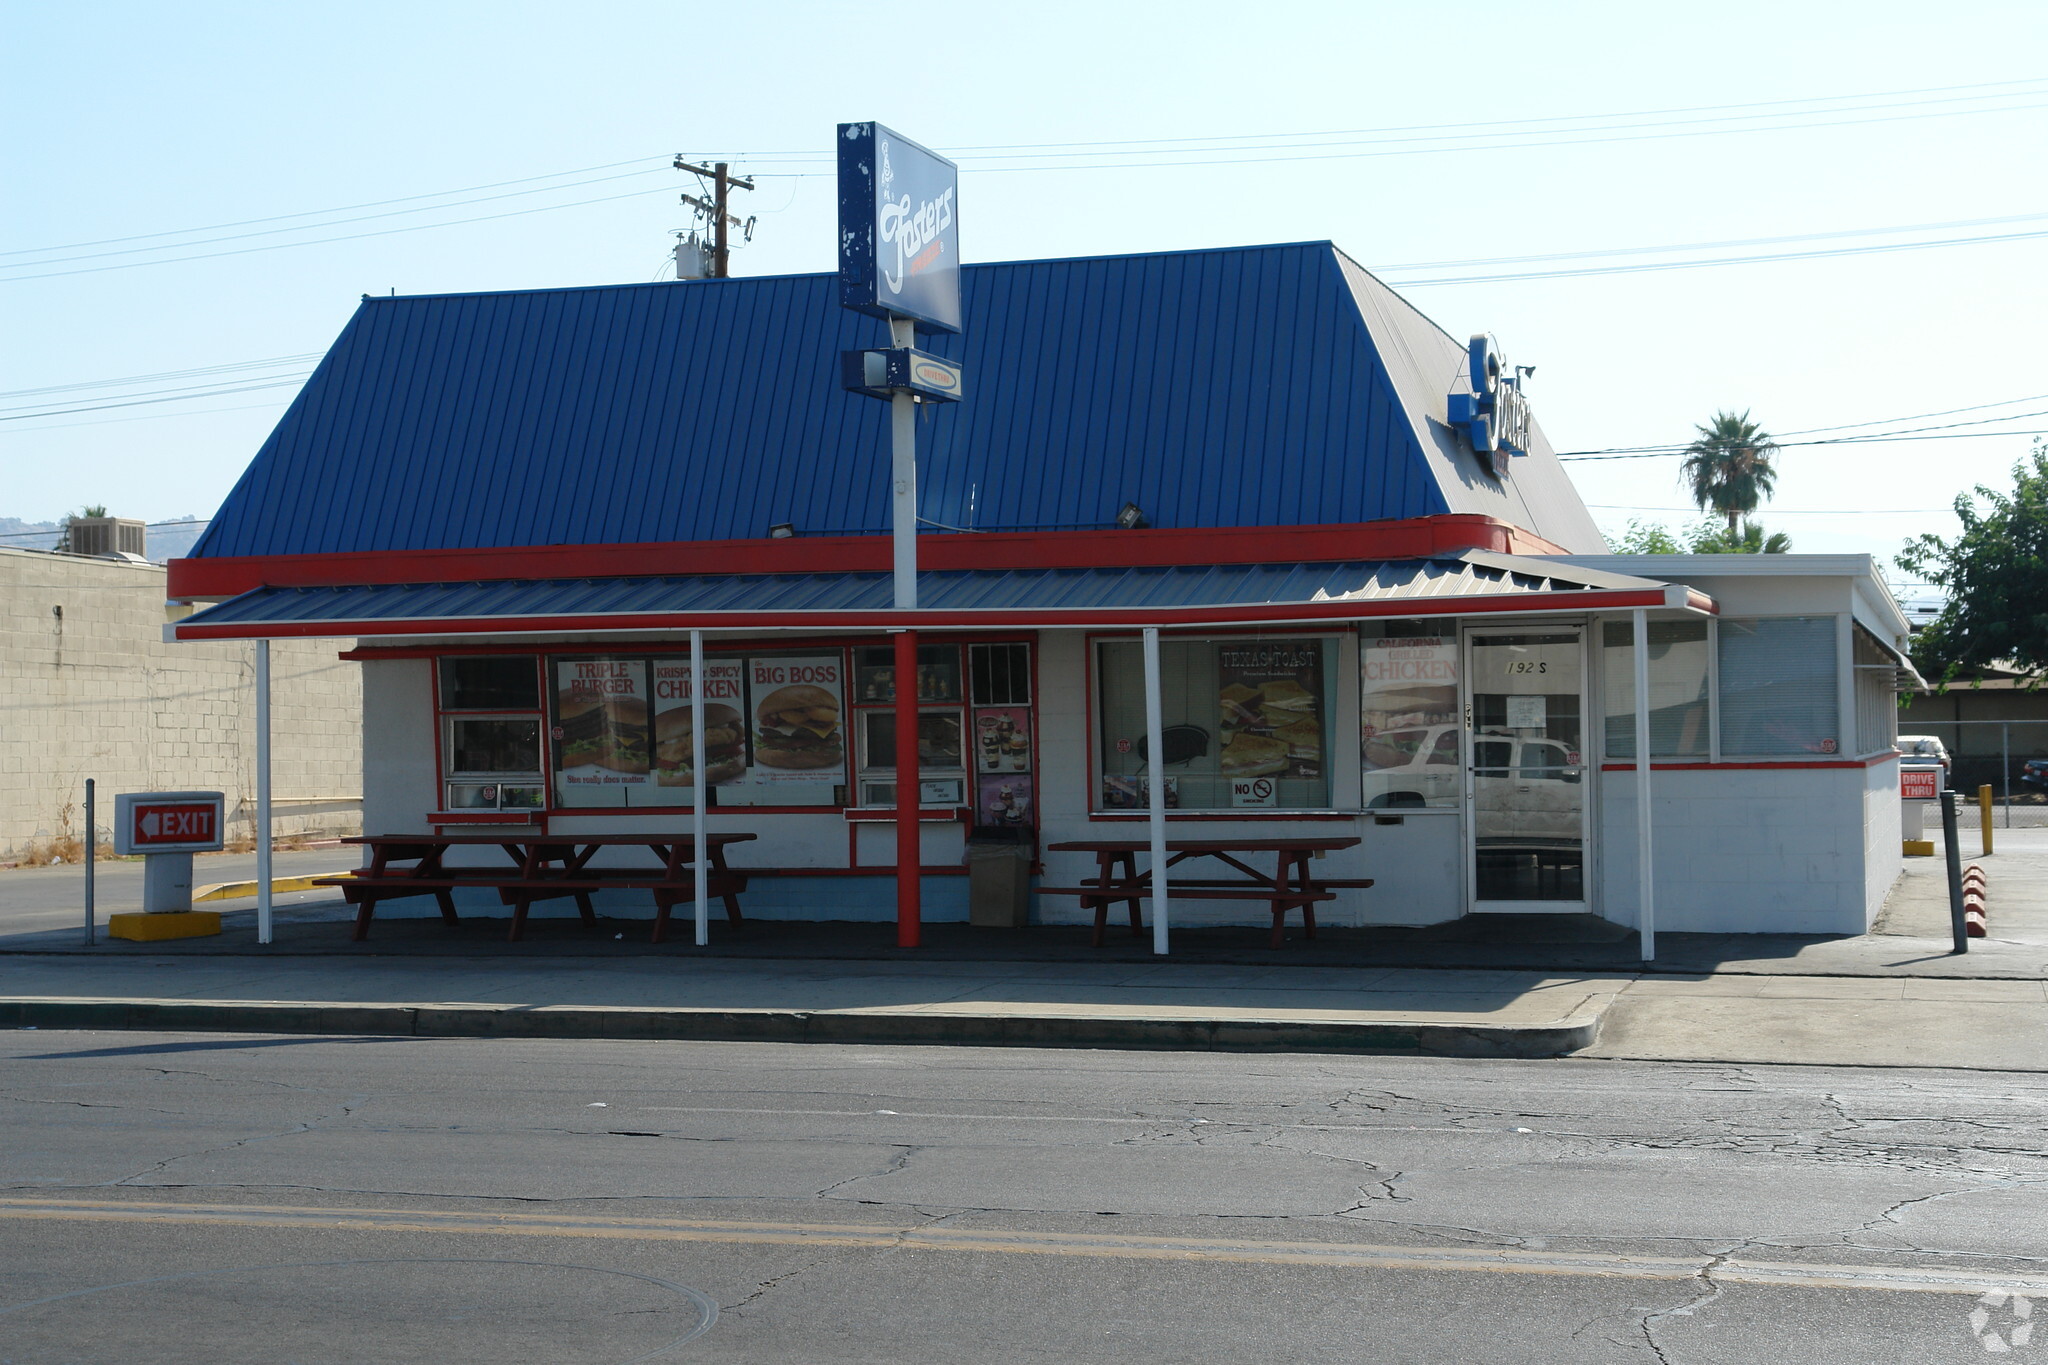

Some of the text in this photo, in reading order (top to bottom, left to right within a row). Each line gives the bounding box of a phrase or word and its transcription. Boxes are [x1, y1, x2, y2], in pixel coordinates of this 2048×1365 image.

[880, 186, 953, 295] Fosters
[1376, 638, 1442, 648] CALIFORNIA
[1221, 651, 1316, 667] TEXAS TOAST
[575, 663, 629, 678] TRIPLE
[709, 666, 741, 677] SPICY
[755, 666, 837, 684] BIG BOSS
[1365, 660, 1457, 680] CHICKEN
[1508, 662, 1547, 674] 192 S
[571, 679, 636, 694] BURGER
[656, 679, 740, 699] CHIKEN
[1902, 774, 1934, 784] DRIVE
[1235, 784, 1250, 794] NO
[1904, 785, 1932, 796] THRU
[162, 812, 212, 835] EXIT
